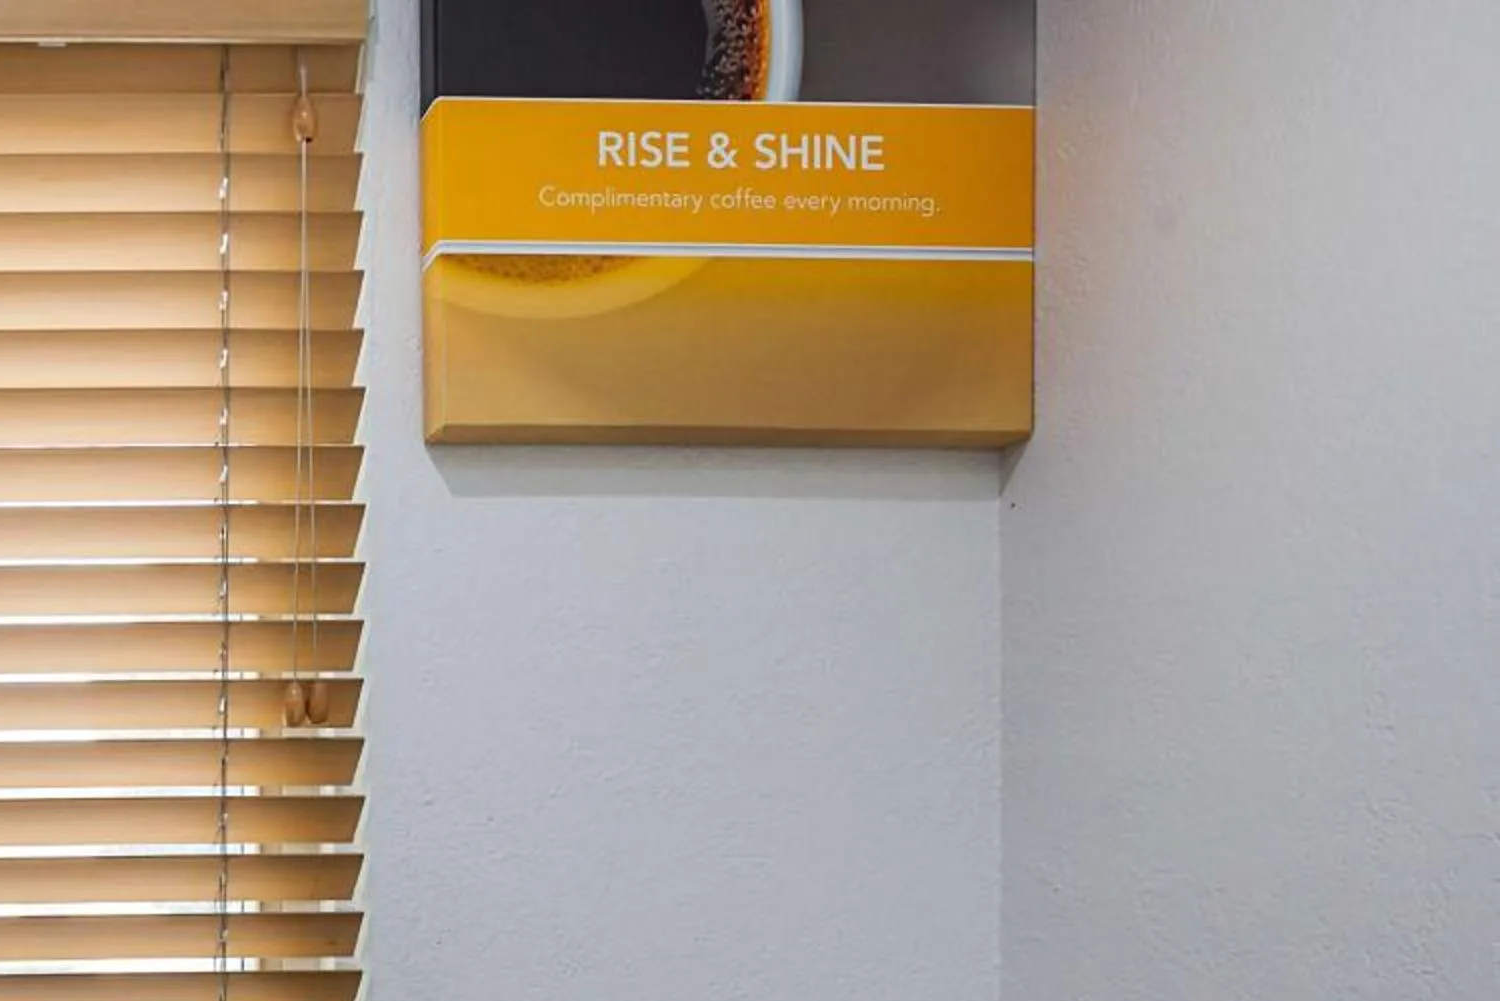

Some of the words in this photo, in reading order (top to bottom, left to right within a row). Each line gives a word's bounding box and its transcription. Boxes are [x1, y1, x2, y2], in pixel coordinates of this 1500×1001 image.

[598, 130, 690, 168] RISE
[707, 132, 738, 169] &
[754, 134, 886, 171] SHINE
[539, 185, 703, 214] Complimentary
[710, 187, 776, 210] coffee
[784, 192, 841, 213] every
[848, 193, 941, 216] morning.
